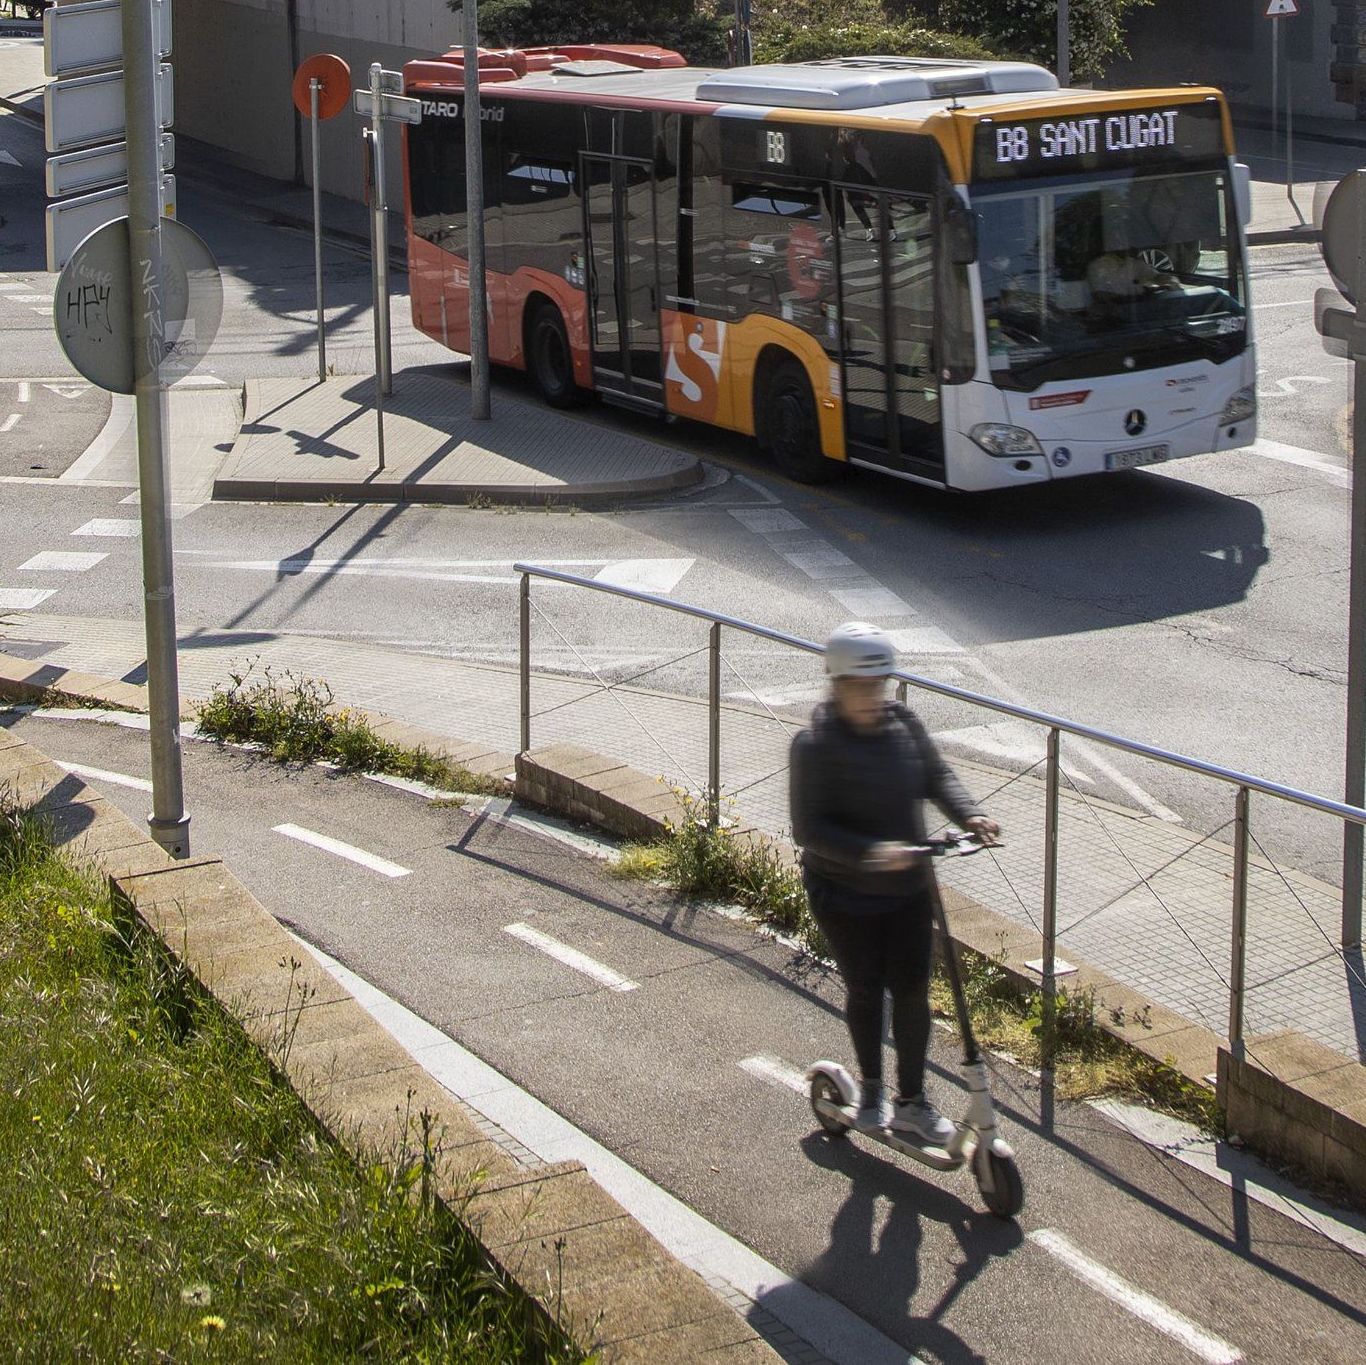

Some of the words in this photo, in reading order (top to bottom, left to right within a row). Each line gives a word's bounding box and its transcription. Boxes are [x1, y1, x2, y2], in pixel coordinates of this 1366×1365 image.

[422, 101, 458, 118] TARO
[766, 131, 785, 163] B8
[996, 126, 1029, 162] B8
[1039, 119, 1100, 157] SANT
[1105, 111, 1178, 151] CUGAT
